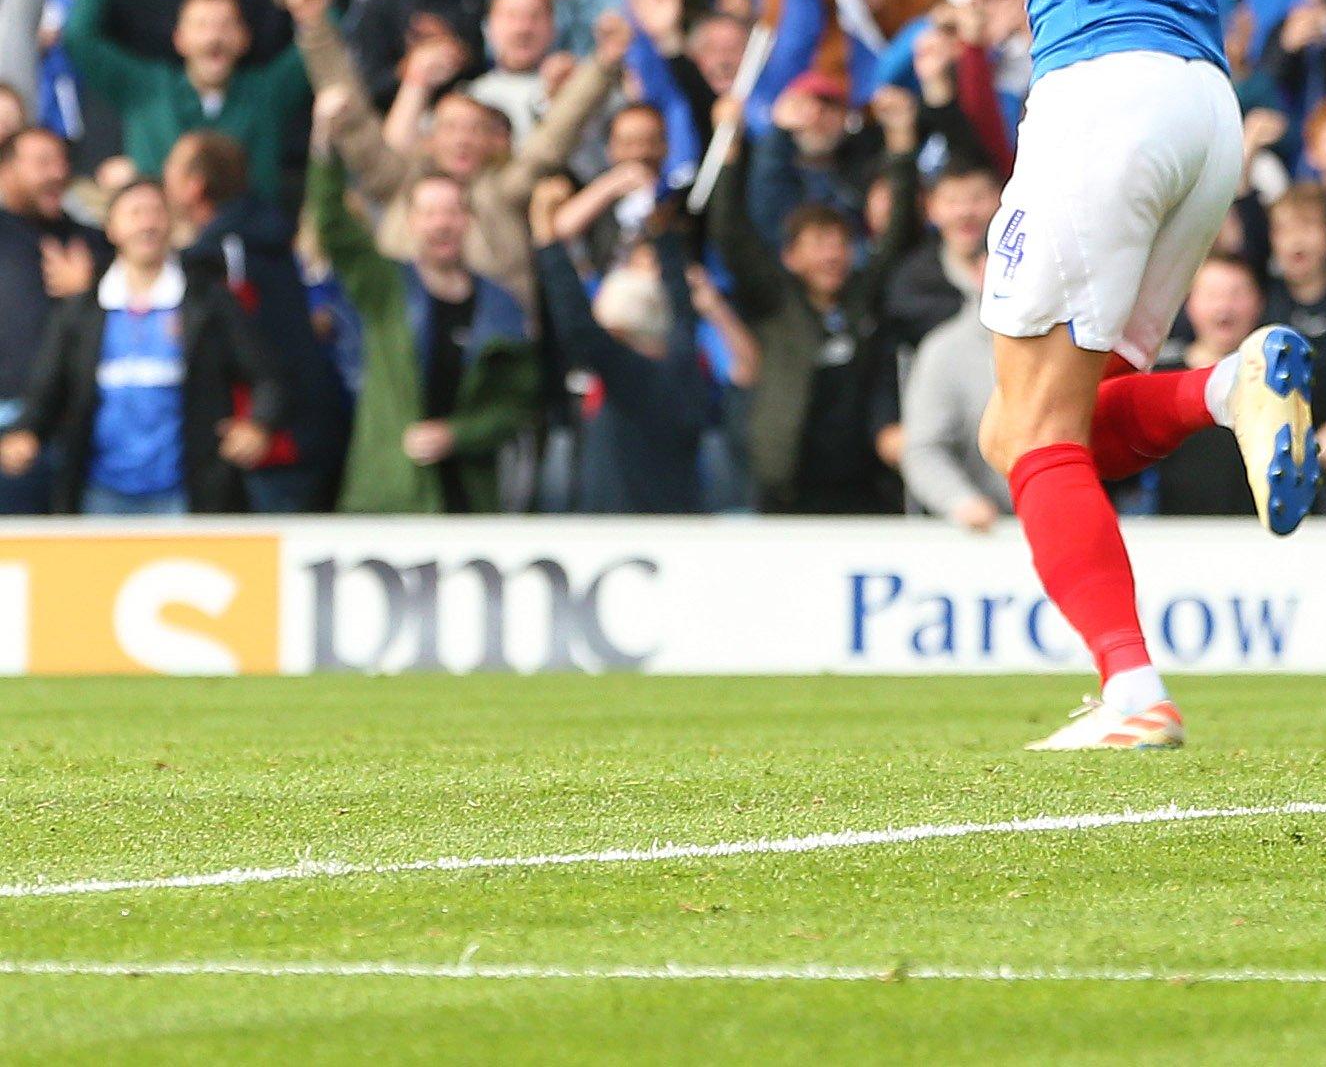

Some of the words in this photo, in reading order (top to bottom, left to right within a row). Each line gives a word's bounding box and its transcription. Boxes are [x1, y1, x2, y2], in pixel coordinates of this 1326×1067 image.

[995, 208, 1026, 280] 4
[301, 557, 658, 672] pmc
[845, 572, 1299, 660] Parcow
